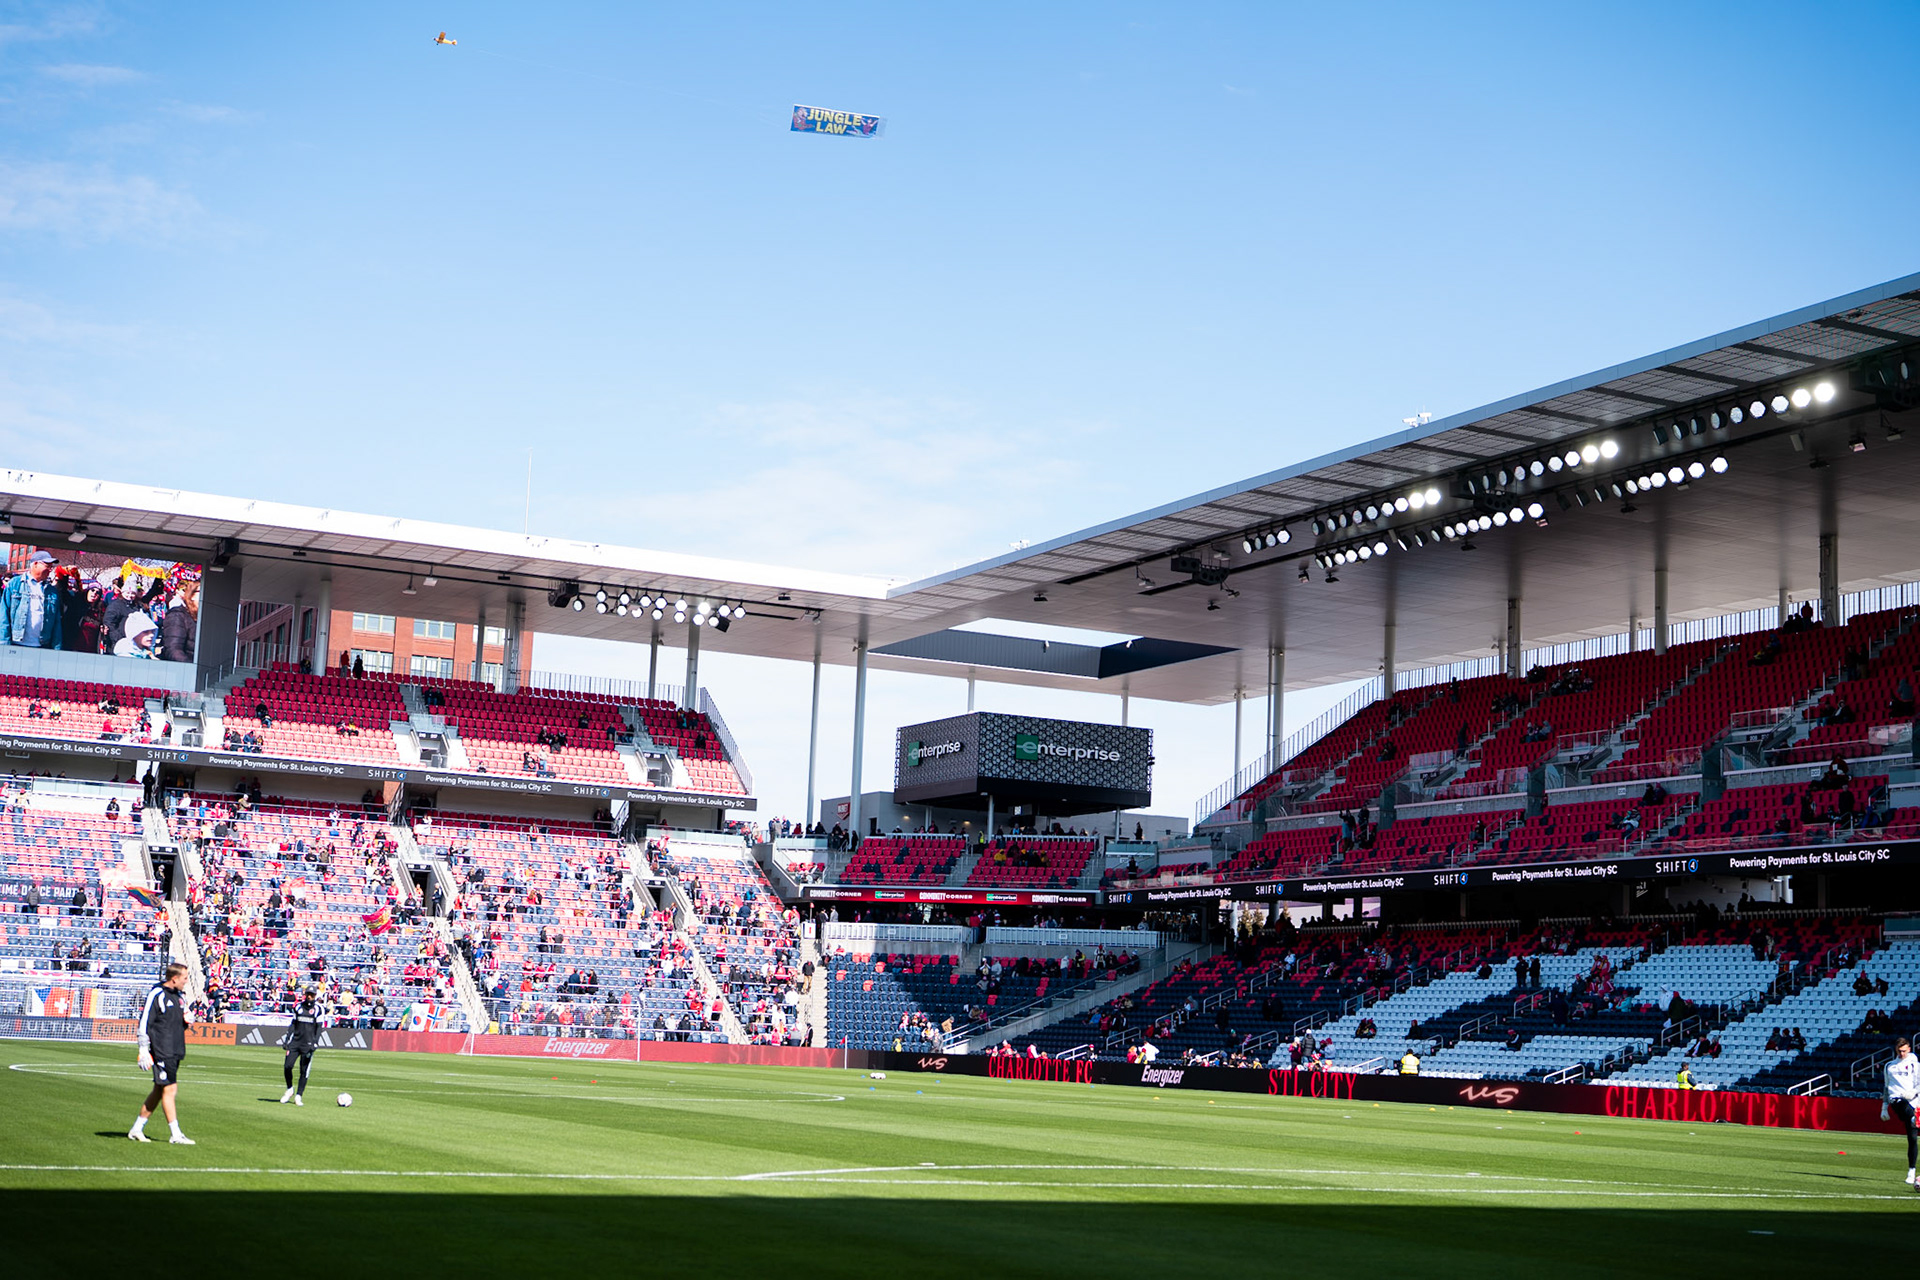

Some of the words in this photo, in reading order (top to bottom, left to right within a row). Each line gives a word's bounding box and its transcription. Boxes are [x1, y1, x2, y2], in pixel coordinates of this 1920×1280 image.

[807, 108, 863, 126] JUNGLE
[815, 121, 848, 134] LAW
[13, 739, 50, 750] Payments
[51, 742, 63, 750] for
[63, 743, 73, 751] St.
[74, 745, 94, 753] Louis
[94, 746, 110, 756] City
[110, 748, 122, 756] SC
[909, 740, 961, 760] enterprise
[1018, 741, 1121, 762] enterprise
[209, 756, 242, 767] Powering
[243, 759, 278, 769] Payments
[279, 762, 289, 770] for
[290, 763, 299, 771] St.
[300, 764, 318, 772] Louis
[319, 766, 334, 775] City
[334, 767, 344, 775] SC
[425, 774, 456, 785] Powering
[457, 777, 490, 787] Payments
[490, 780, 501, 788] for
[501, 781, 510, 789] St.
[510, 782, 527, 790] Louis
[528, 783, 541, 792] City
[541, 784, 552, 792] SC
[627, 791, 656, 802] Powering
[657, 794, 687, 803] Payments
[688, 796, 698, 804] for
[706, 798, 722, 806] Louis
[723, 799, 736, 808] City
[736, 800, 745, 808] SC
[1730, 857, 1766, 869] Powering
[1768, 855, 1808, 868] Payments
[1809, 853, 1821, 863] for
[1822, 852, 1833, 863] St.
[1835, 851, 1857, 862] Louis
[1858, 849, 1877, 863] City
[1877, 848, 1890, 860] SC
[1492, 872, 1521, 882] Powering
[1522, 869, 1553, 881] Payments
[1554, 868, 1564, 877] for
[1564, 867, 1574, 877] St.
[1574, 866, 1592, 876] Louis
[1593, 865, 1607, 877] City
[1607, 865, 1618, 875] SC
[21, 885, 51, 896] DCE
[1148, 892, 1168, 901] Powering
[1168, 891, 1189, 900] Payments
[1189, 890, 1197, 898] for
[1202, 889, 1214, 897] Louis
[1214, 888, 1224, 897] City
[1223, 887, 1231, 896] SC
[1303, 883, 1327, 893] Powering
[1327, 881, 1353, 892] Payments
[1352, 880, 1361, 888] for
[1361, 879, 1369, 888] St.
[1369, 879, 1383, 887] Louis
[1383, 878, 1395, 889] City
[1395, 877, 1404, 886] SC
[27, 1020, 84, 1033] ULTRA
[198, 1025, 235, 1039] Tire
[543, 1037, 610, 1057] Energizer
[988, 1056, 1070, 1082] CHARLOTTE
[1076, 1060, 1093, 1084] FC
[1141, 1065, 1185, 1087] Energizer
[1268, 1069, 1303, 1097] STL
[1310, 1071, 1357, 1099] CITY
[1605, 1085, 1780, 1127] CHARLOTTE
[1794, 1094, 1828, 1130] FC
